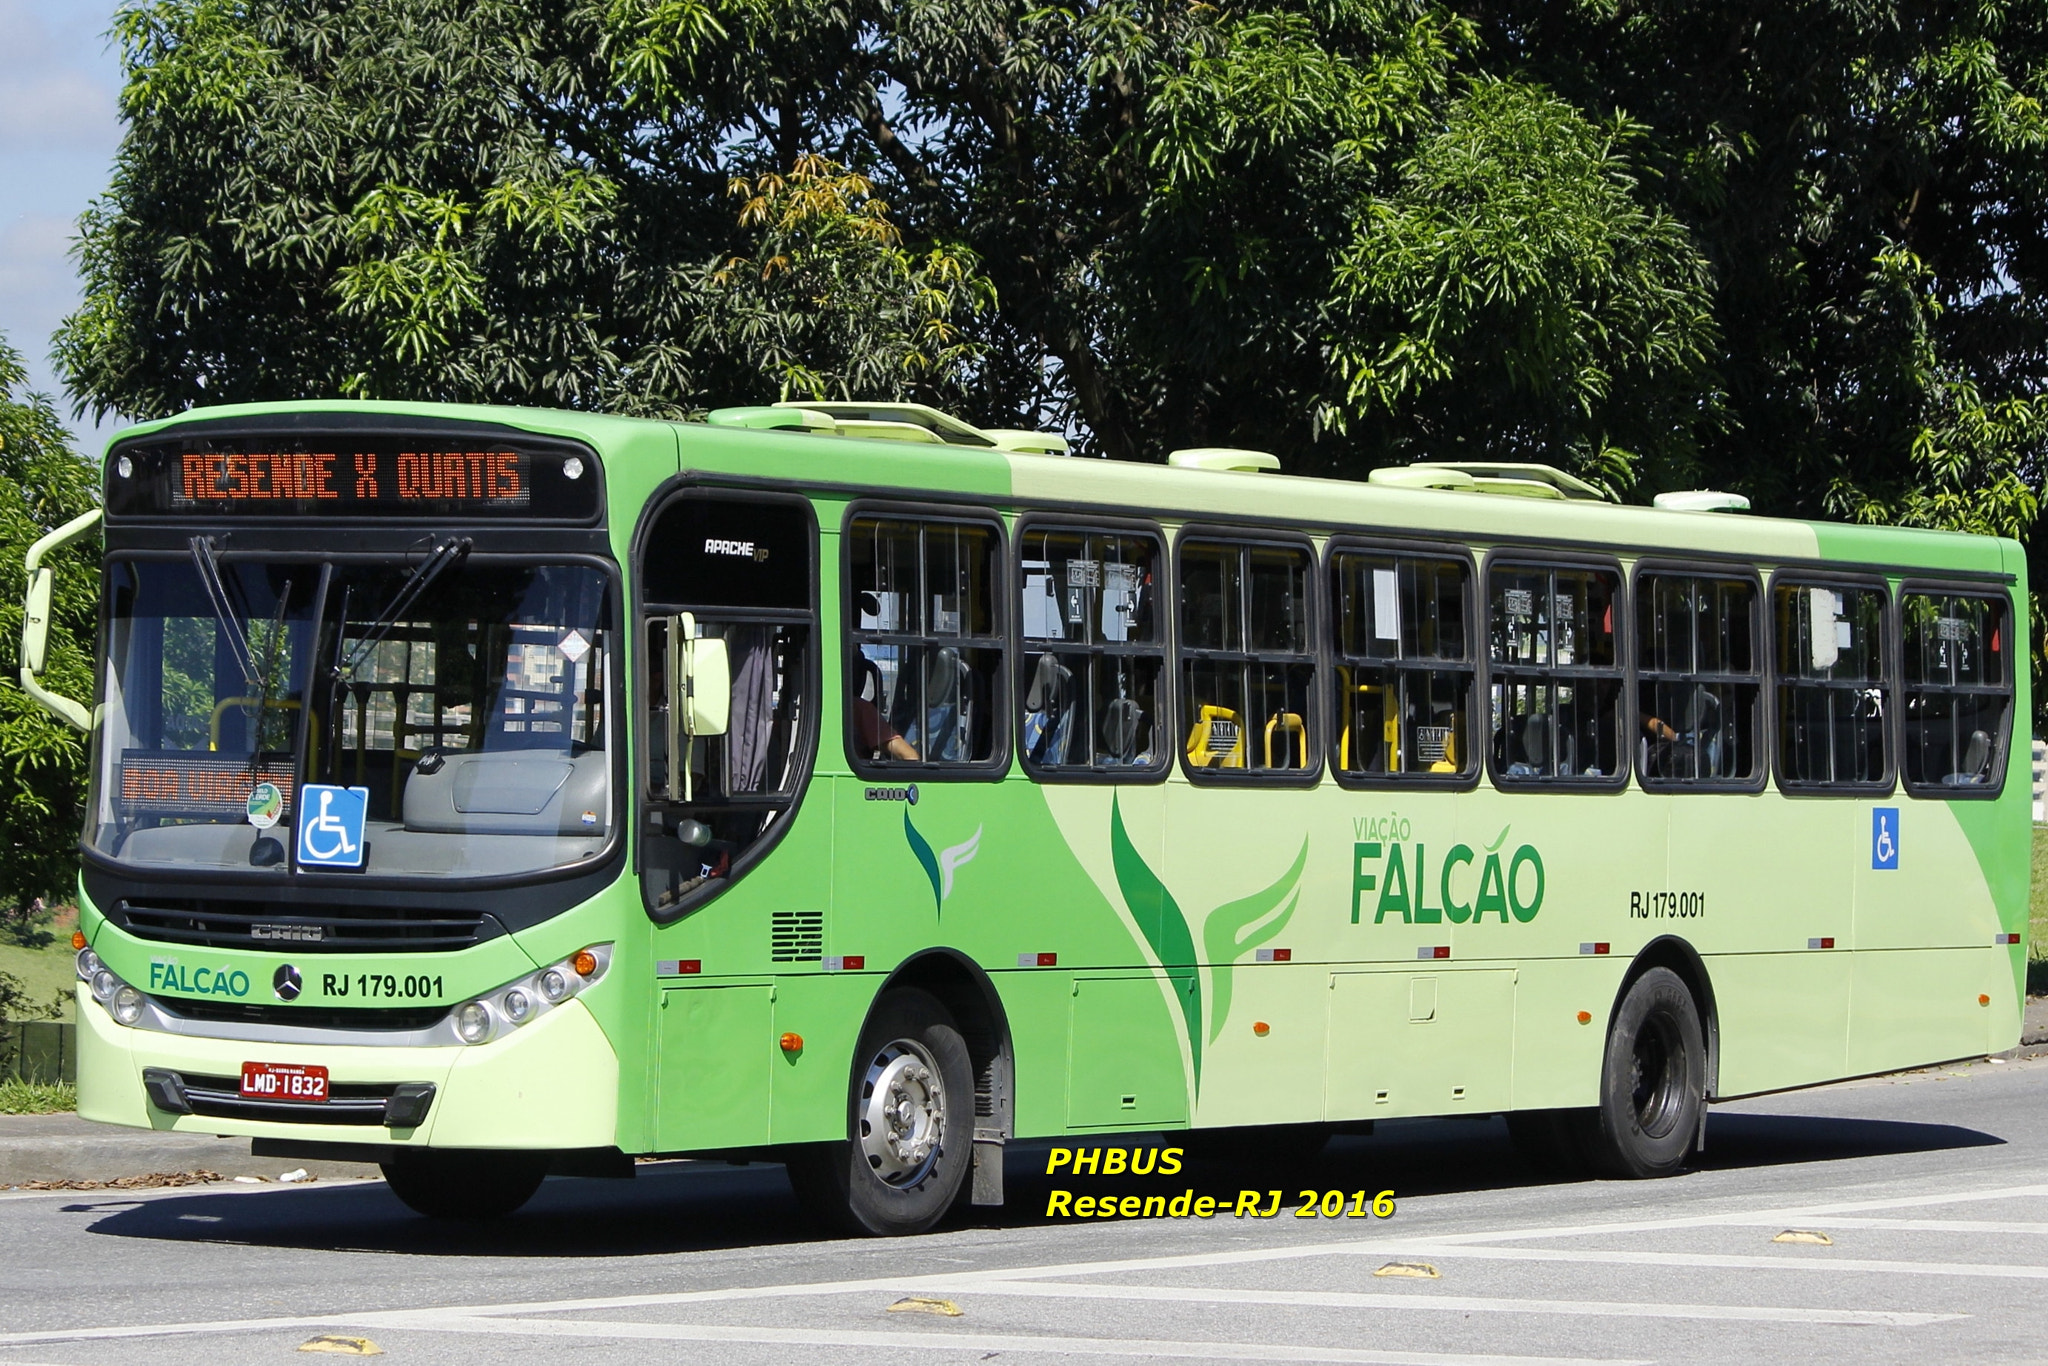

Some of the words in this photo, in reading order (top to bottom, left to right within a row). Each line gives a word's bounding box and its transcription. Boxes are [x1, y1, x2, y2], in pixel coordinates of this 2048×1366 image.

[182, 453, 339, 499] RESENDE
[354, 453, 378, 498] X
[397, 452, 520, 498] QUATIS
[704, 538, 755, 557] APACHE
[753, 548, 769, 562] VIP
[123, 768, 179, 800] BOA
[864, 787, 907, 801] CAIO
[1352, 811, 1411, 847] VIAÇÃO
[1630, 891, 1650, 919] RJ
[1652, 891, 1705, 919] 179.001
[322, 973, 349, 997] RJ
[357, 974, 443, 998] 179.001
